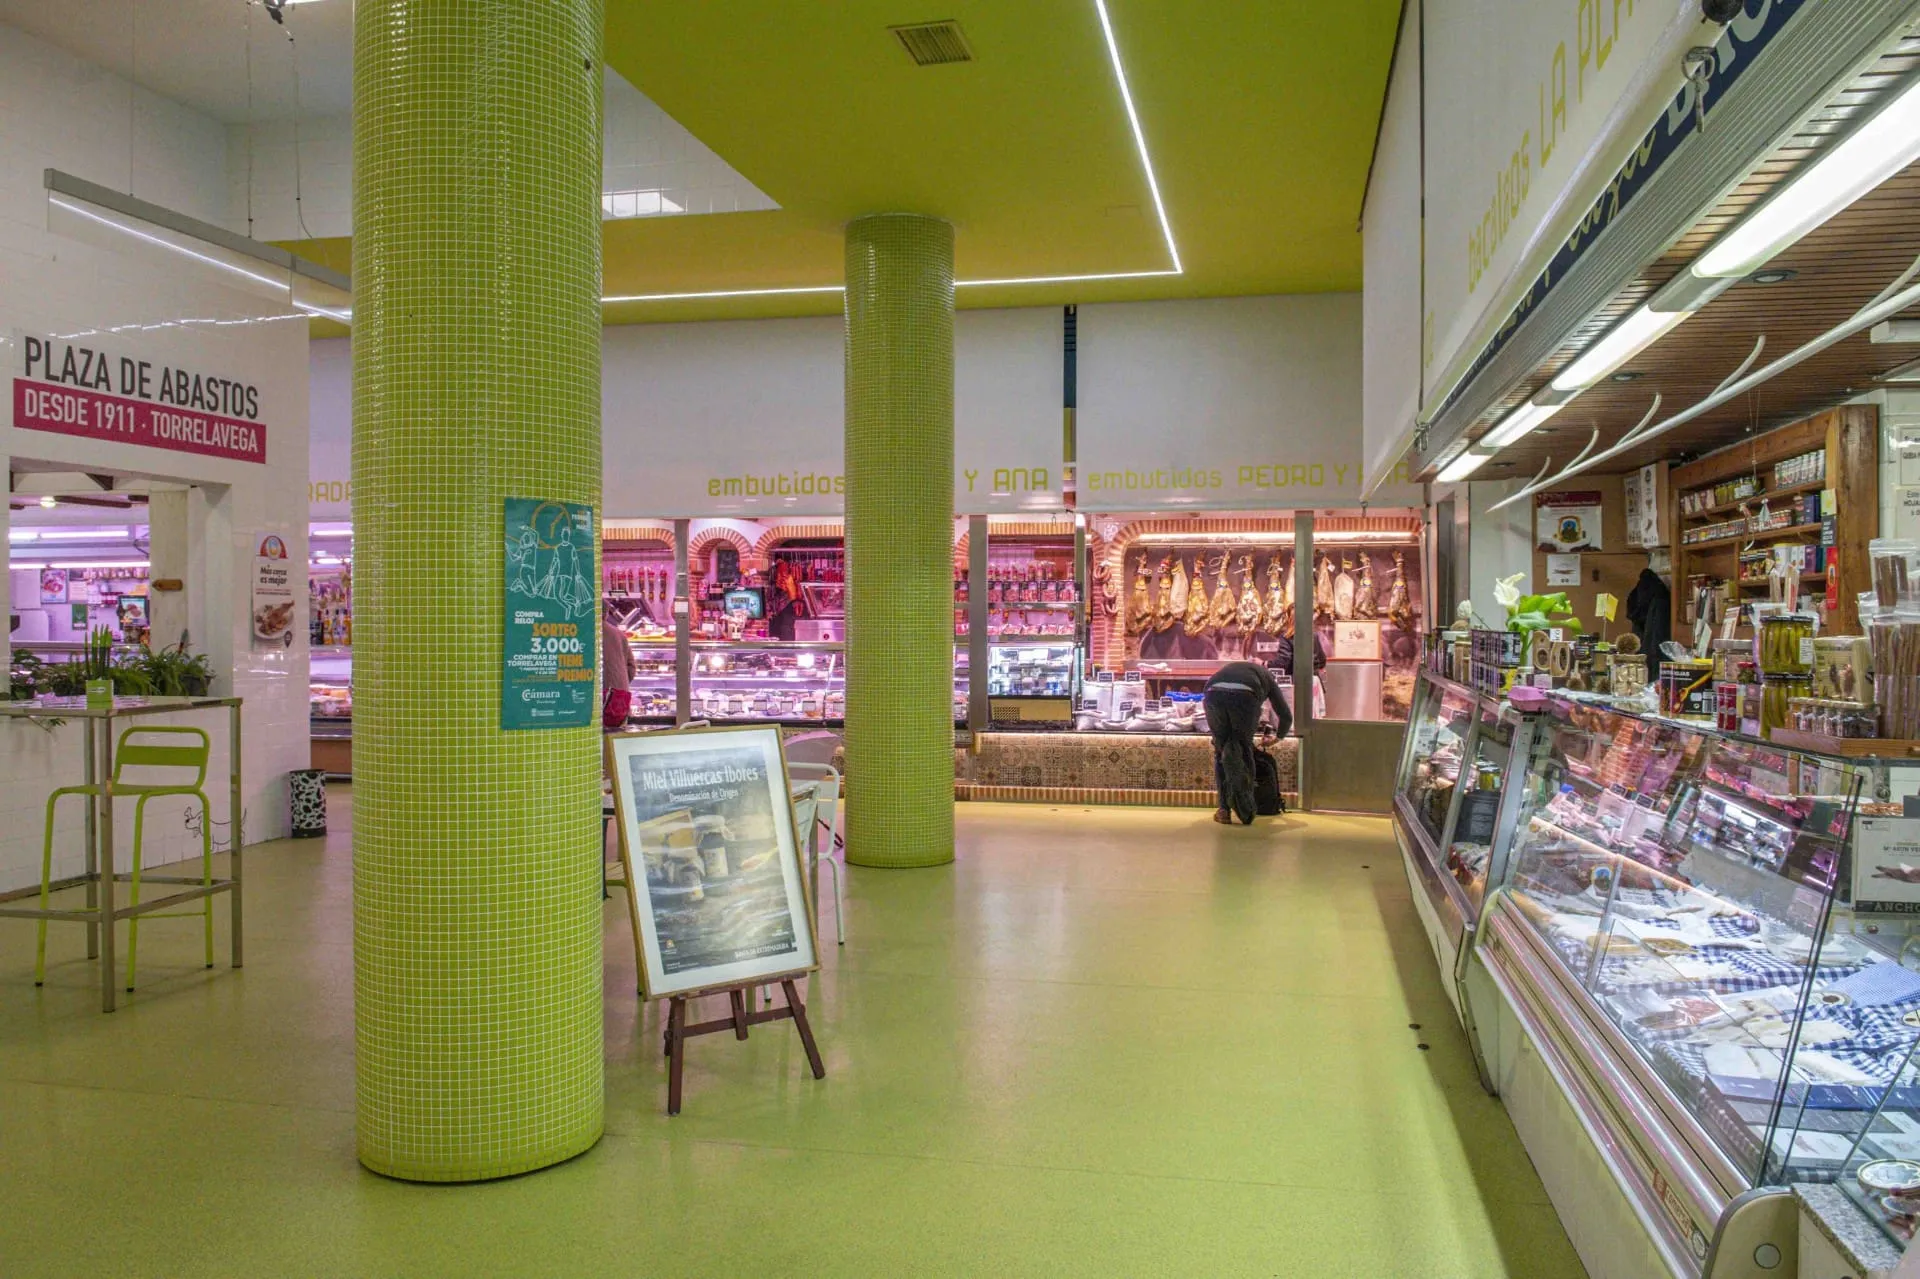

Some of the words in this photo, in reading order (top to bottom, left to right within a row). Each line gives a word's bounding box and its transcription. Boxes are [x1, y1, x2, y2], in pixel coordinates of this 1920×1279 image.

[1540, 40, 1566, 168] LA
[24, 336, 111, 392] PLAZA
[121, 357, 151, 398] DE
[159, 366, 259, 420] ABASTOS
[24, 388, 88, 426] DESDE
[94, 401, 135, 432] 1911
[150, 410, 259, 453] TORRELAVEGA
[707, 470, 846, 497] embutidos
[964, 469, 979, 492] Y
[993, 467, 1049, 491] ANA
[1087, 468, 1222, 491] embutidos
[1237, 464, 1324, 488] PEDRO
[1333, 464, 1347, 485] Y
[533, 623, 577, 637] SORTEO
[557, 669, 594, 682] PREMIO
[643, 770, 667, 791] Miel
[669, 768, 723, 789] Villuercas
[724, 765, 758, 783] Ibores
